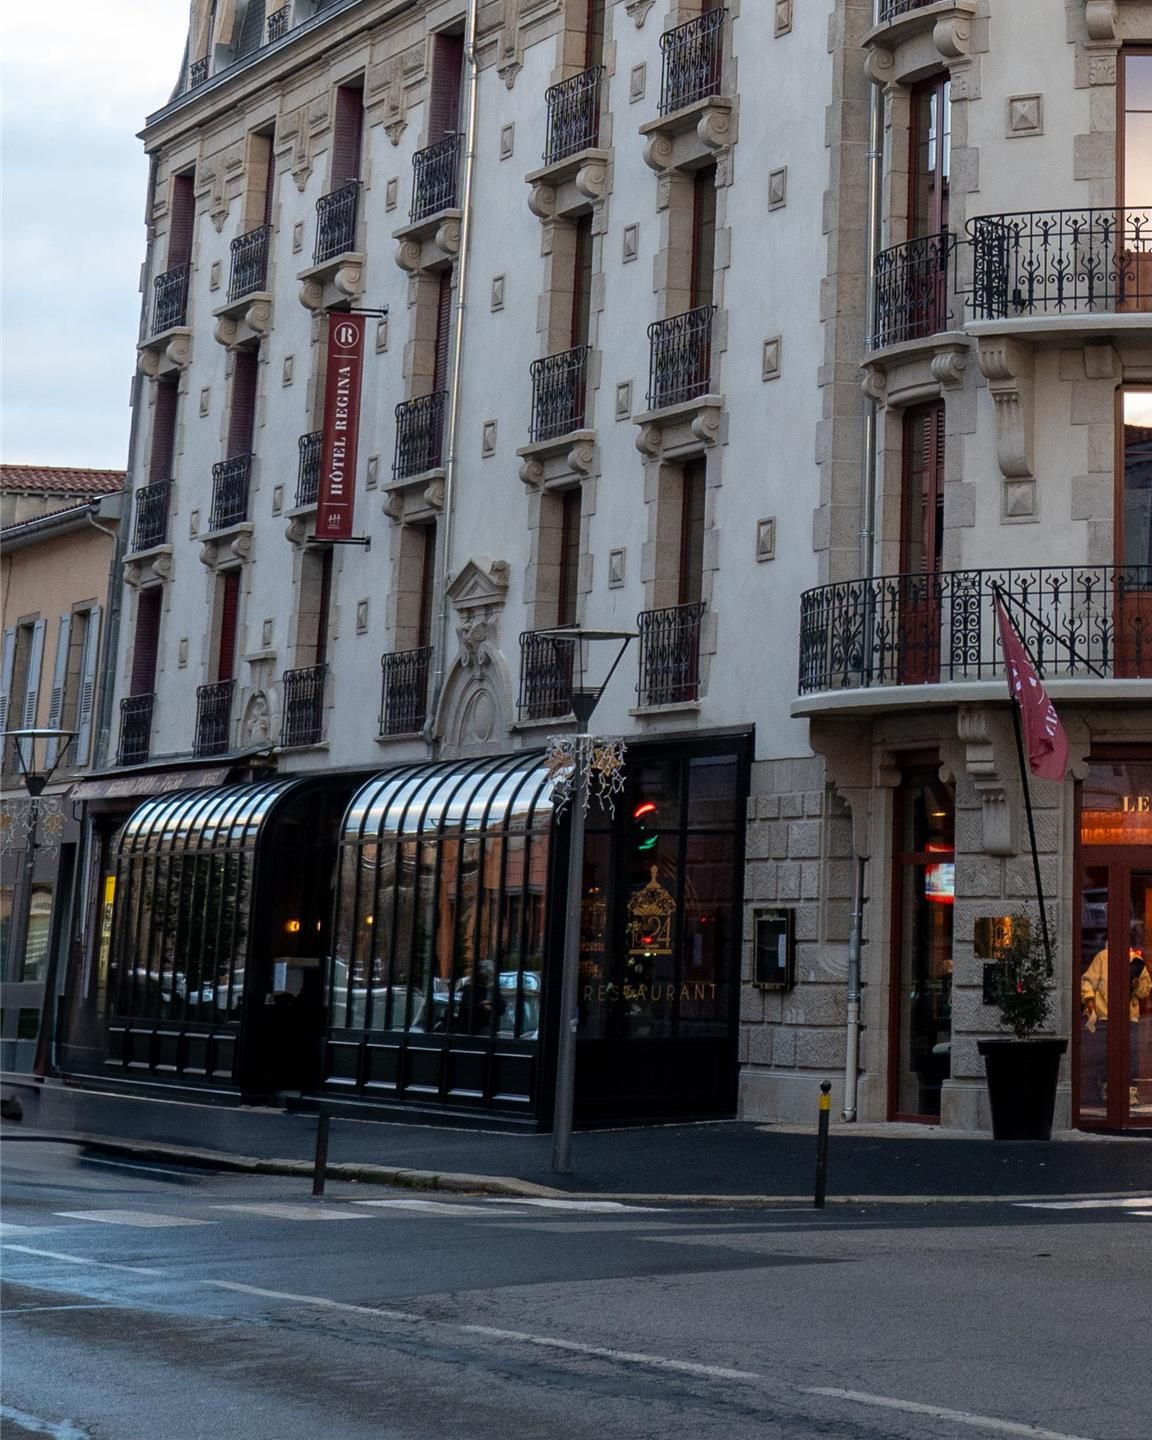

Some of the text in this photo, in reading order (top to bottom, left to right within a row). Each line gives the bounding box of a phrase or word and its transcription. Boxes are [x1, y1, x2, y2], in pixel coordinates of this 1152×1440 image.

[340, 327, 353, 343] R
[329, 366, 352, 496] HÔTEL REGINA
[1122, 796, 1150, 813] LE
